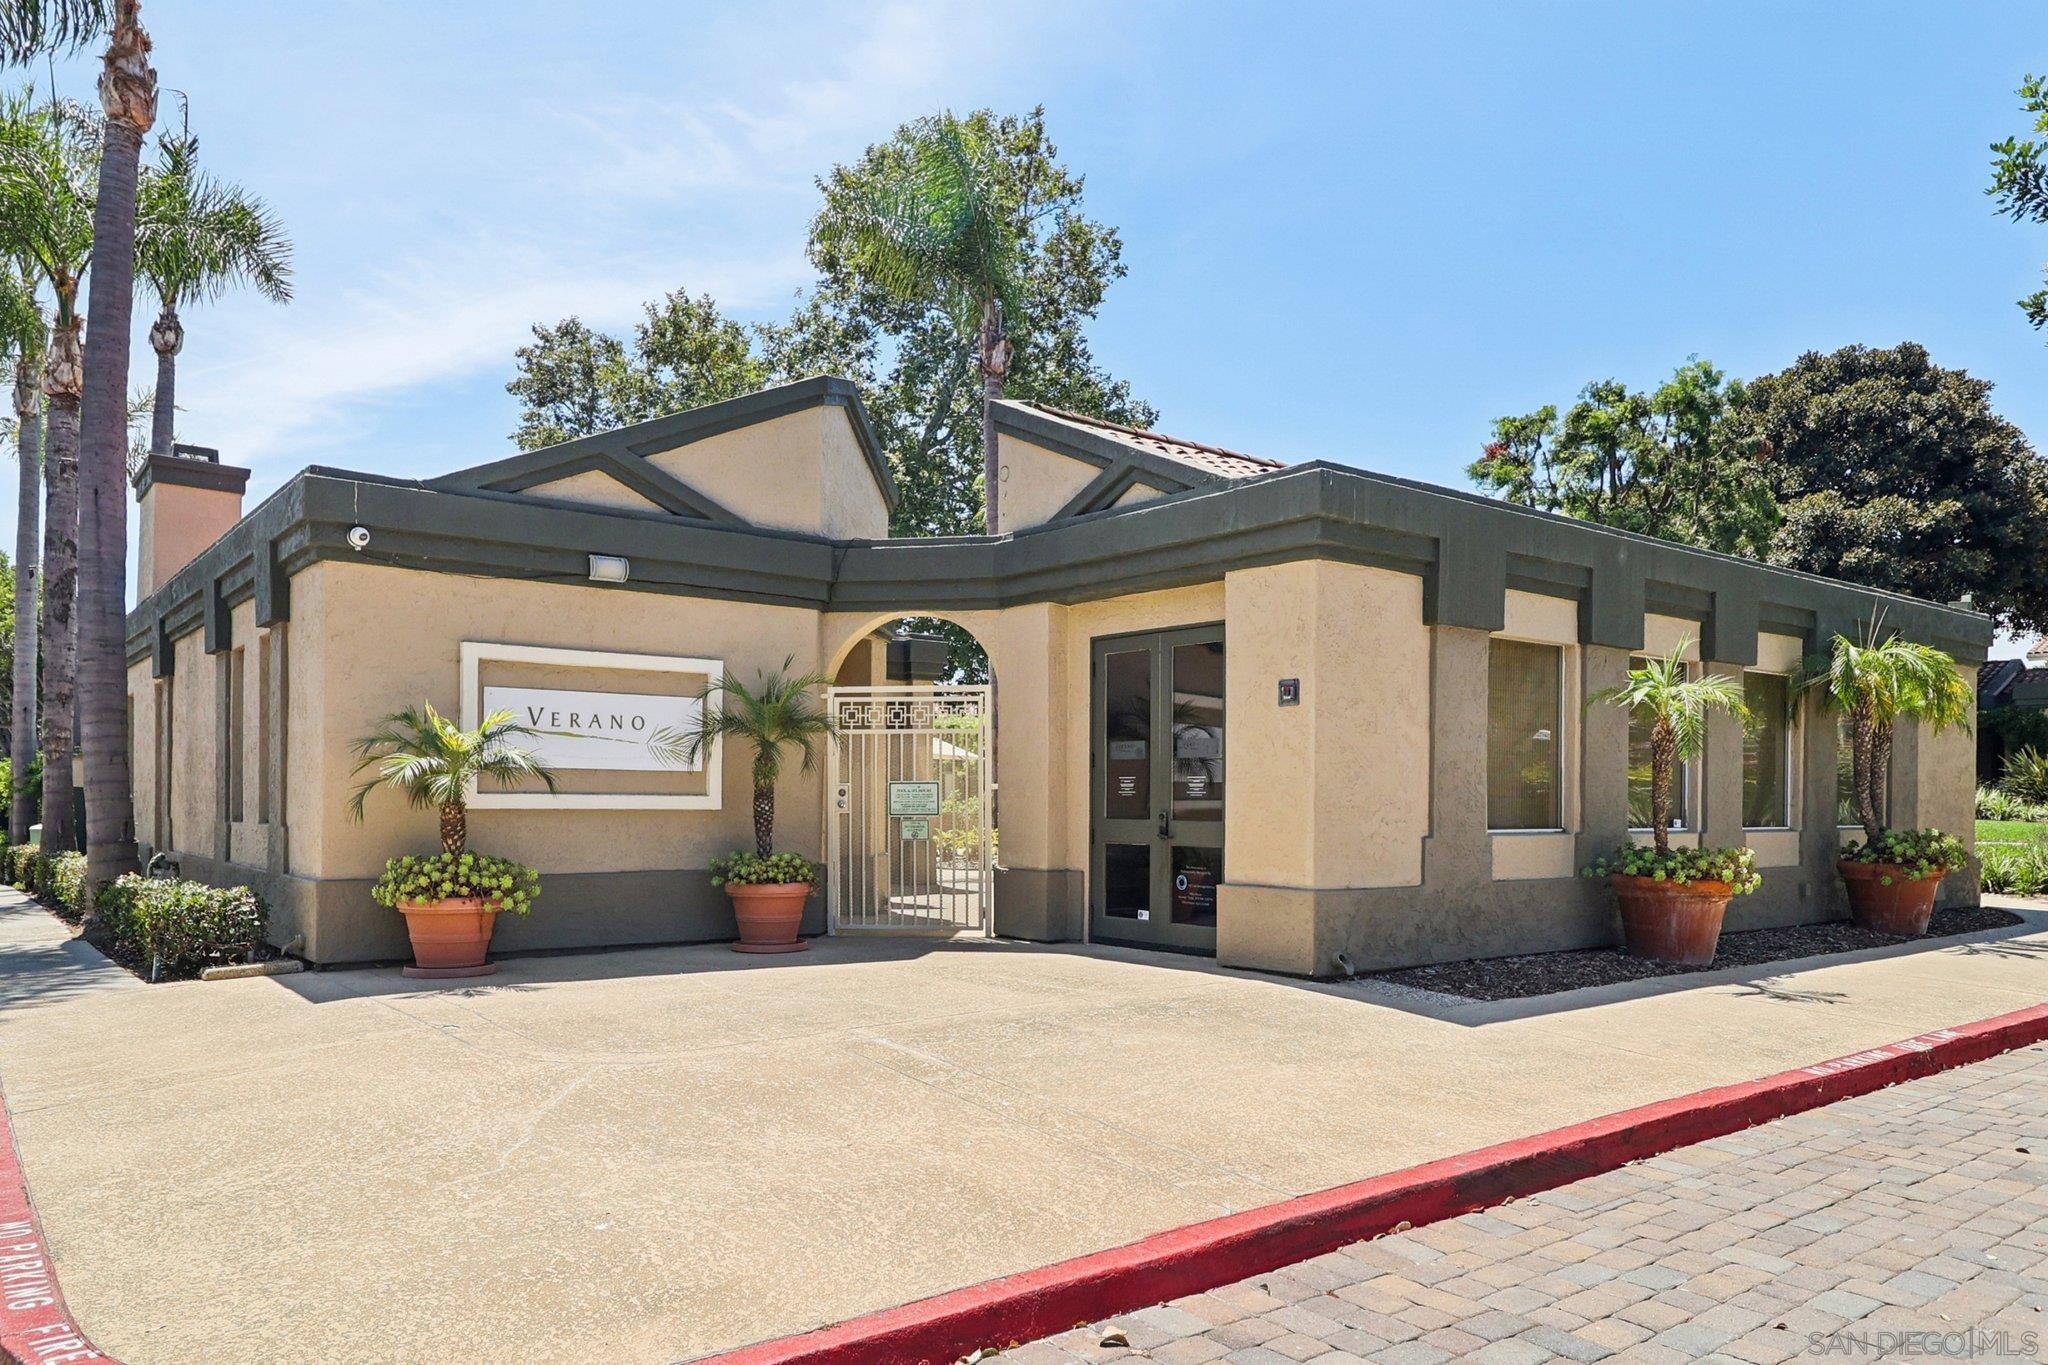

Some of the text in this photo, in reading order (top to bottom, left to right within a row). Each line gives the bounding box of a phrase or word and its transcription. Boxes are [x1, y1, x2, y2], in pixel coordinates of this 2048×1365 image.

[527, 706, 646, 731] VERANO
[0, 1220, 101, 1365] NO PARKING FIRE
